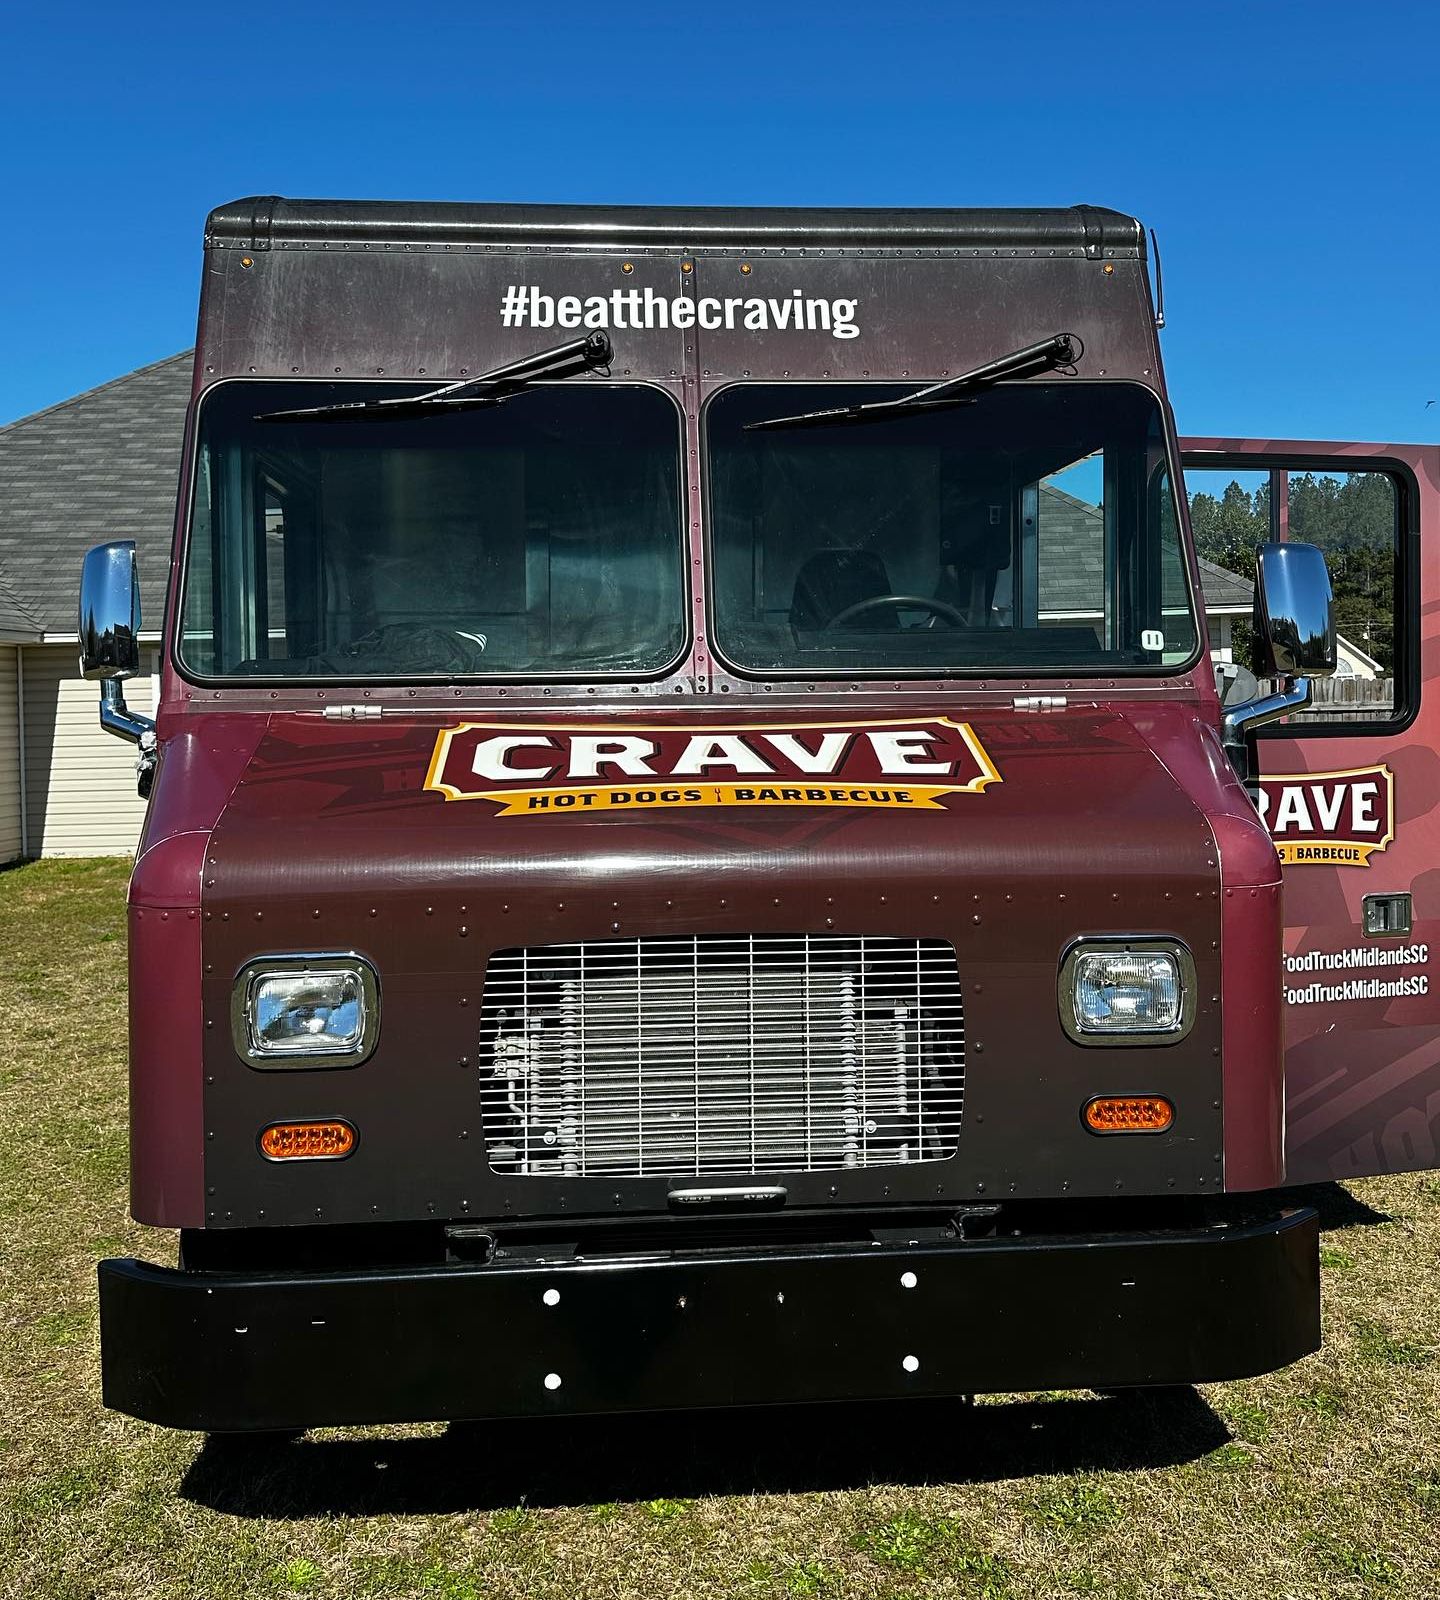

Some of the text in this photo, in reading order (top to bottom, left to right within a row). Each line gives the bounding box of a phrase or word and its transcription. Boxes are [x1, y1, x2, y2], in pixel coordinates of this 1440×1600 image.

[500, 286, 860, 338] #beatthecraving
[471, 730, 954, 781] CRAVE
[528, 788, 915, 809] HOT DOGS BARBECUE
[1296, 847, 1360, 861] BARBECUE
